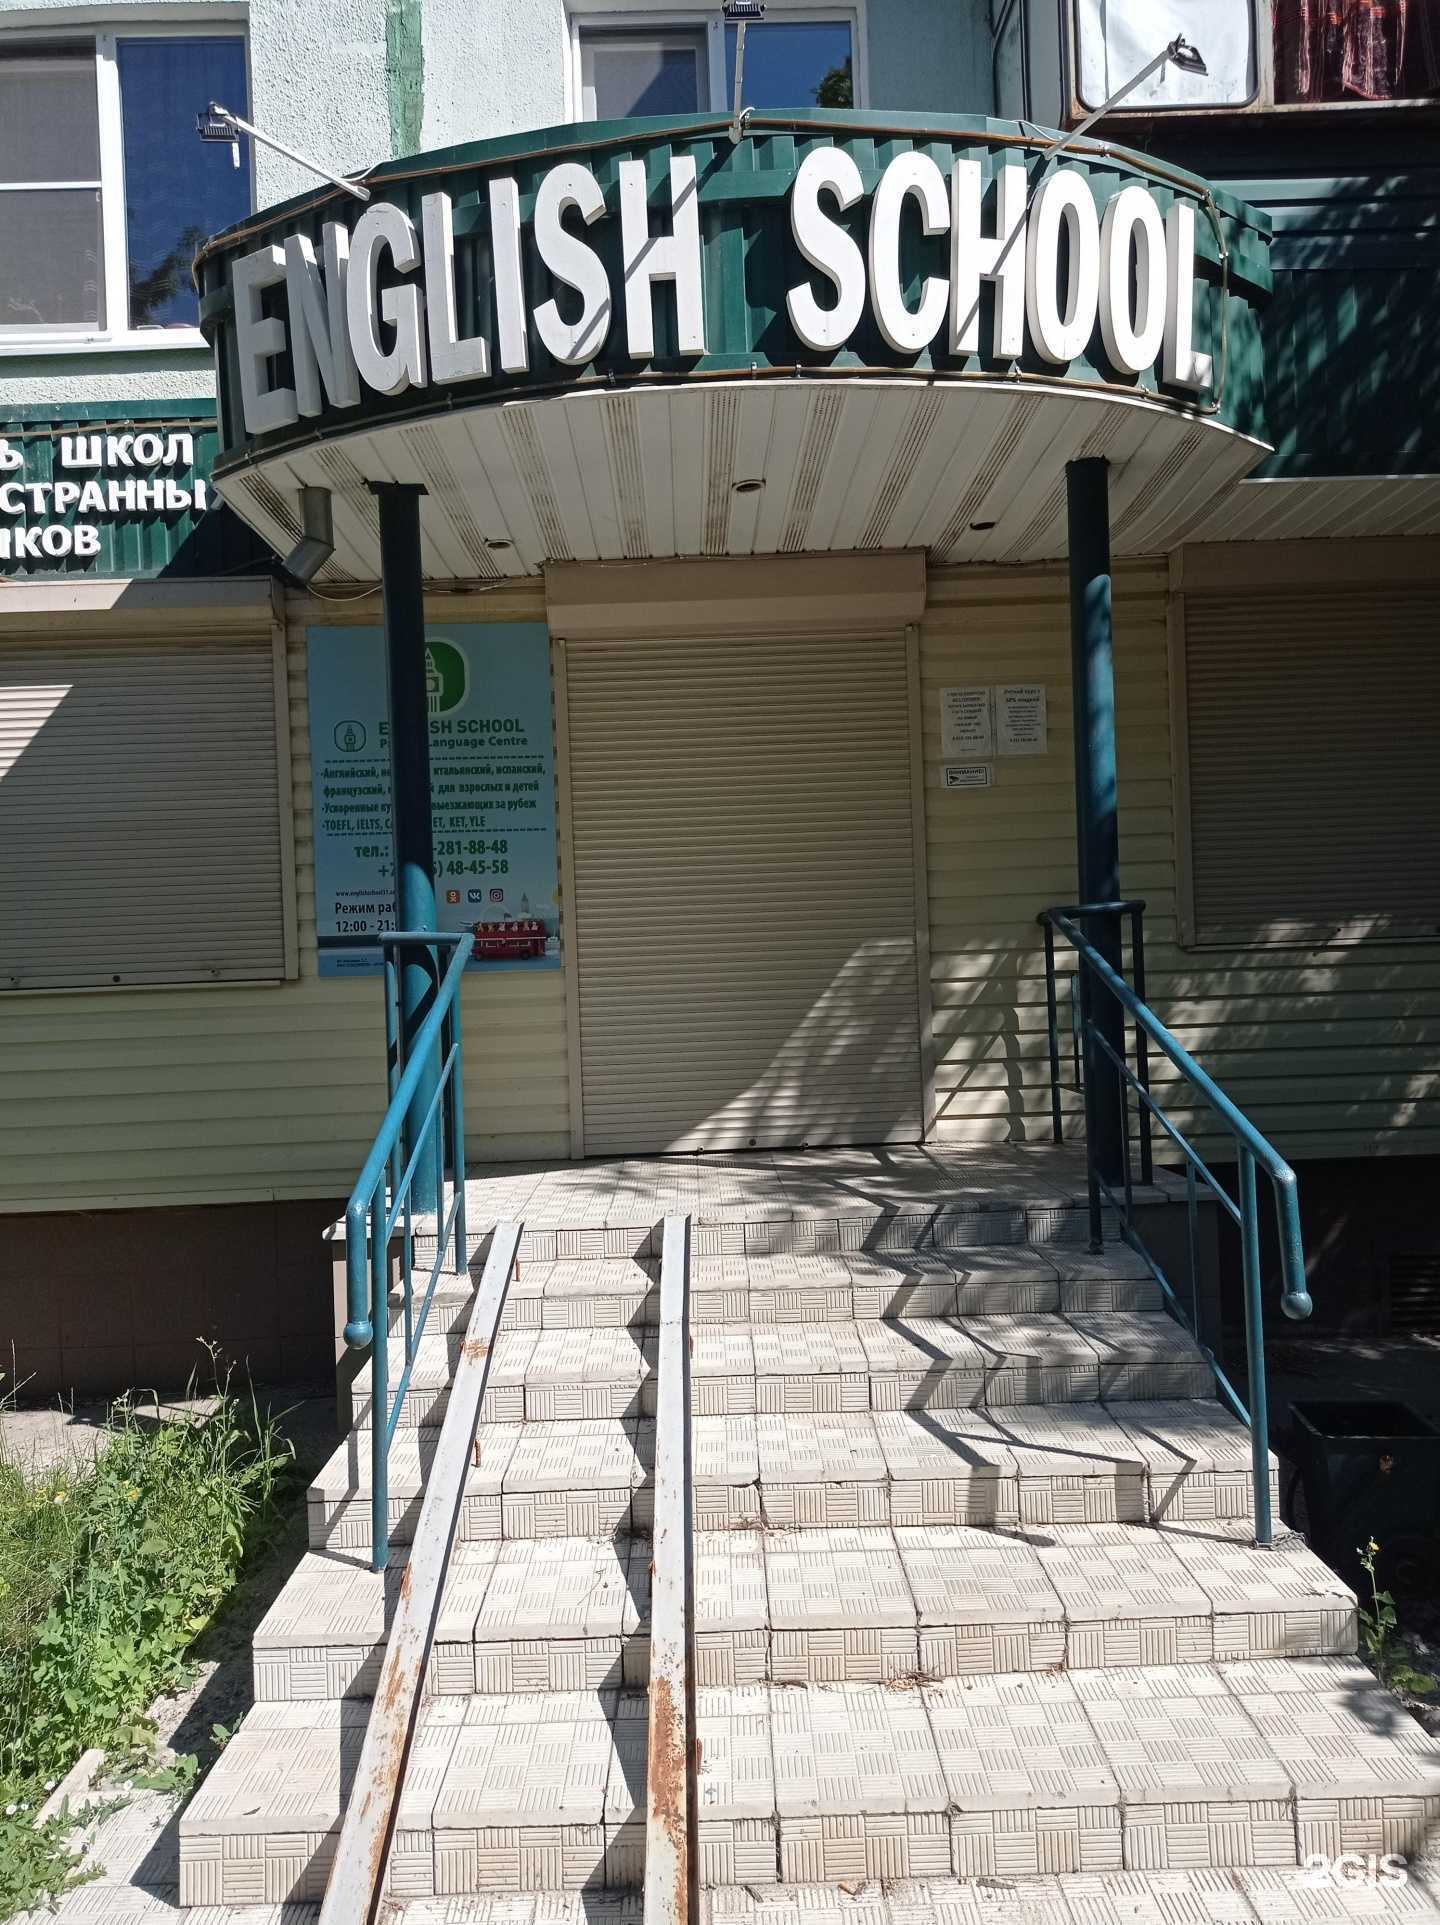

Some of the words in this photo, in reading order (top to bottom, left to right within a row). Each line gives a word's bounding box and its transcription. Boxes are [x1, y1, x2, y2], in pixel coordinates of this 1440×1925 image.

[232, 155, 707, 433] ENGLISH
[788, 147, 1214, 389] SCHOOL
[61, 433, 193, 468] ШКОЛ
[457, 719, 525, 734] SCHOOL
[429, 738, 485, 749] anguage
[488, 736, 528, 746] Centre
[496, 763, 546, 776] испанский,
[438, 783, 455, 794] для
[459, 783, 504, 795] взрослых
[512, 780, 540, 793] детей
[495, 800, 506, 809] за
[507, 798, 537, 811] рубеж
[357, 818, 384, 831] IELTS,
[432, 816, 446, 828] ET,
[449, 816, 468, 828] KET,
[469, 816, 486, 827] YLE
[354, 845, 389, 858] тел.:
[446, 859, 509, 876] 48-45-58
[335, 902, 375, 916] Режим
[335, 920, 367, 933] 12:00
